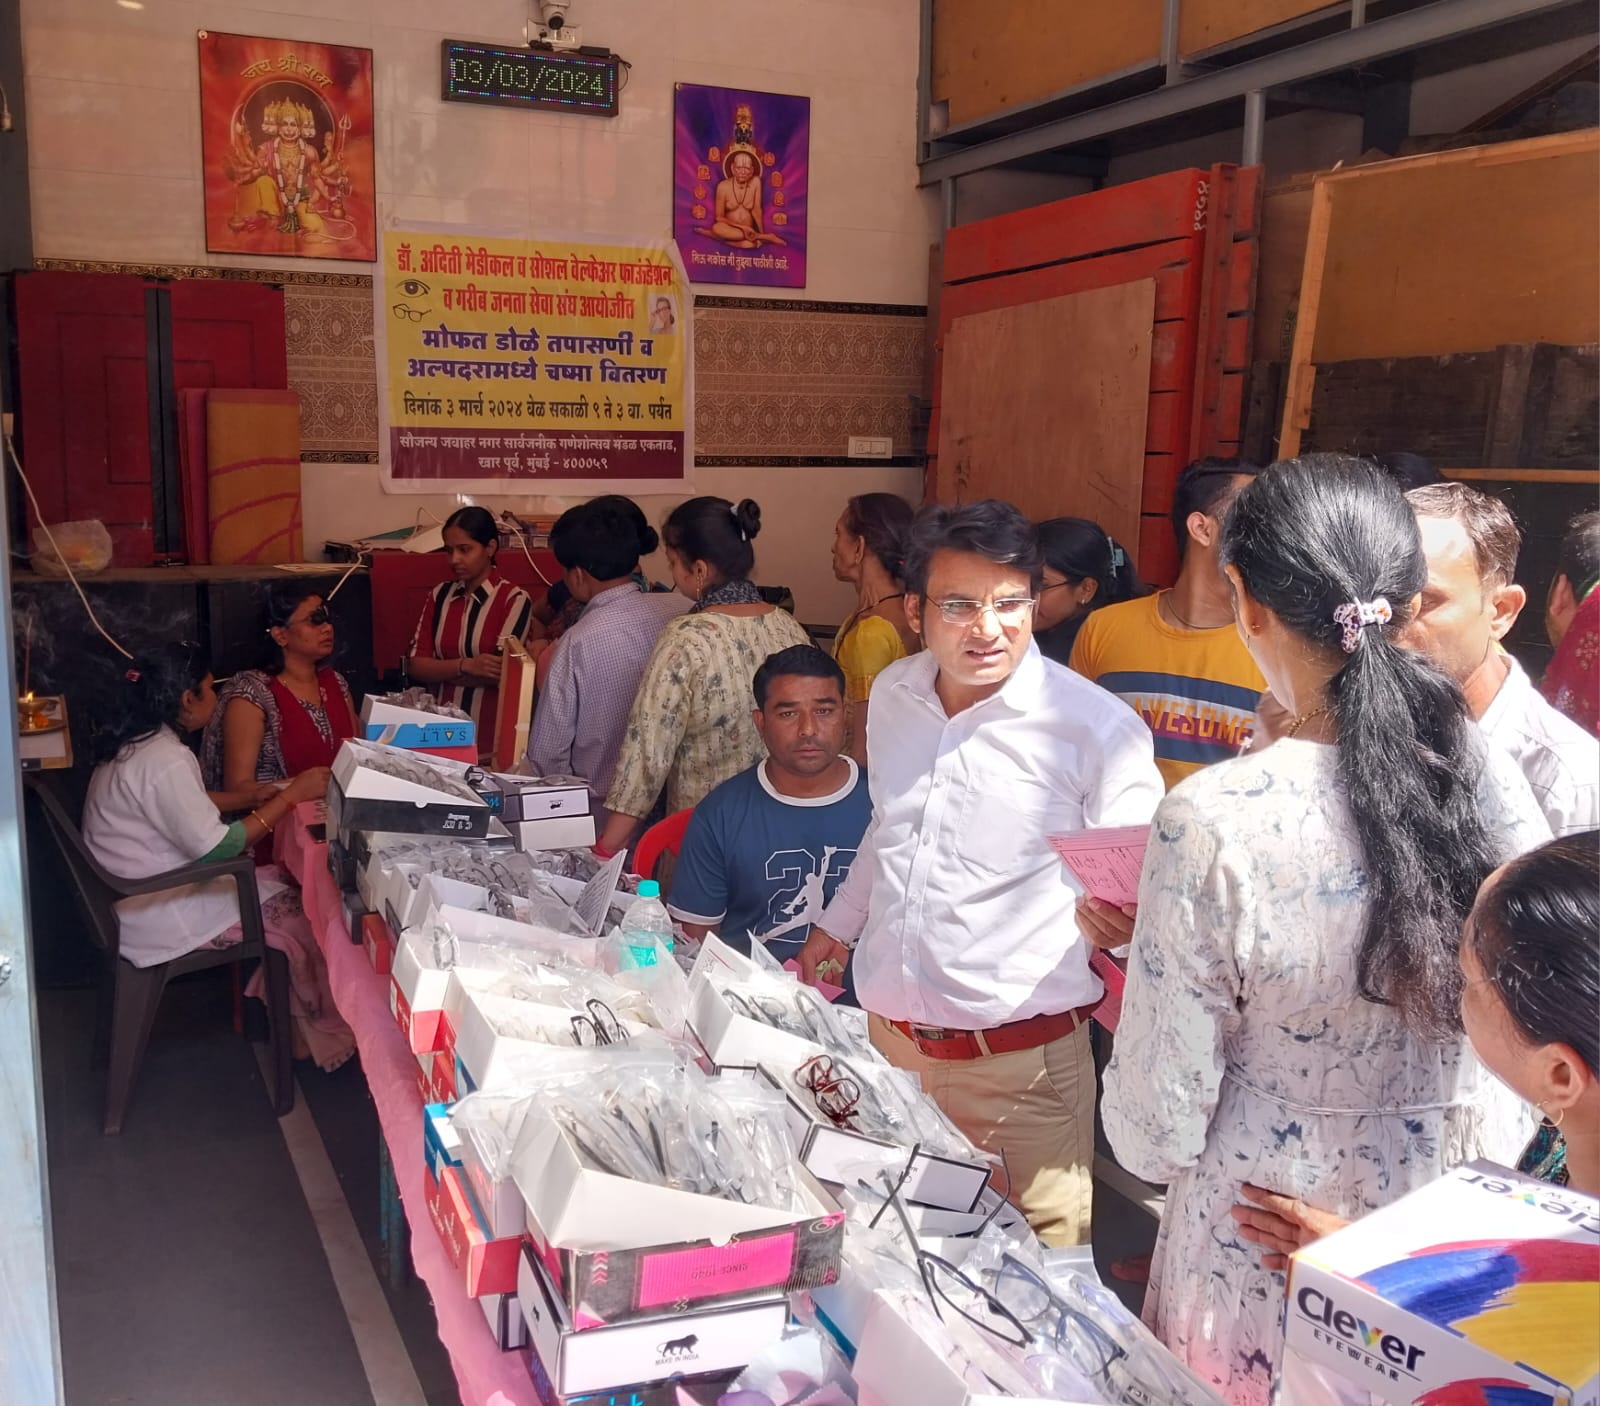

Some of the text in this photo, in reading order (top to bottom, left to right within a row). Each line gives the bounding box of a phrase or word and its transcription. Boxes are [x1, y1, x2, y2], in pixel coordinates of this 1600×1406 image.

[240, 52, 334, 88] जय श्री राम
[452, 58, 604, 96] 03/03/2024
[397, 243, 417, 273] डॉ.
[420, 244, 462, 275] अदिती
[465, 246, 515, 277] मेडीकल
[517, 255, 527, 278] व
[529, 250, 568, 280] सोशल
[570, 252, 617, 283] वेल्फेअर
[442, 282, 635, 319] व गरीब जनता सेवा संघ आयोजीत
[422, 323, 654, 356] मोफत डोळे तपासणी व
[408, 356, 667, 384] अल्पदरामध्ये चष्मा वितरण
[403, 390, 442, 415] दिनांक
[446, 399, 454, 418] ३
[458, 391, 483, 416] मार्च
[488, 400, 522, 417] २०२४
[526, 394, 545, 417] वेळ
[549, 394, 588, 418] सकाळी
[593, 401, 600, 419] ९
[604, 396, 613, 419] ते
[616, 403, 623, 421] ३
[628, 403, 644, 419] वा.
[440, 436, 476, 449] जवाहर
[478, 437, 501, 449] नगर
[503, 433, 557, 450] सार्वजनीक
[559, 434, 611, 450] गणेशोत्सव
[613, 435, 638, 450] मंडळ
[478, 457, 501, 469] खार
[526, 452, 550, 473] मुंबई
[562, 457, 608, 470] ४०००५९
[1297, 1286, 1426, 1372] Clever
[655, 1357, 673, 1366] MAKE
[682, 1353, 699, 1361] INDIA
[1313, 1328, 1400, 1382] EYEWEAR
